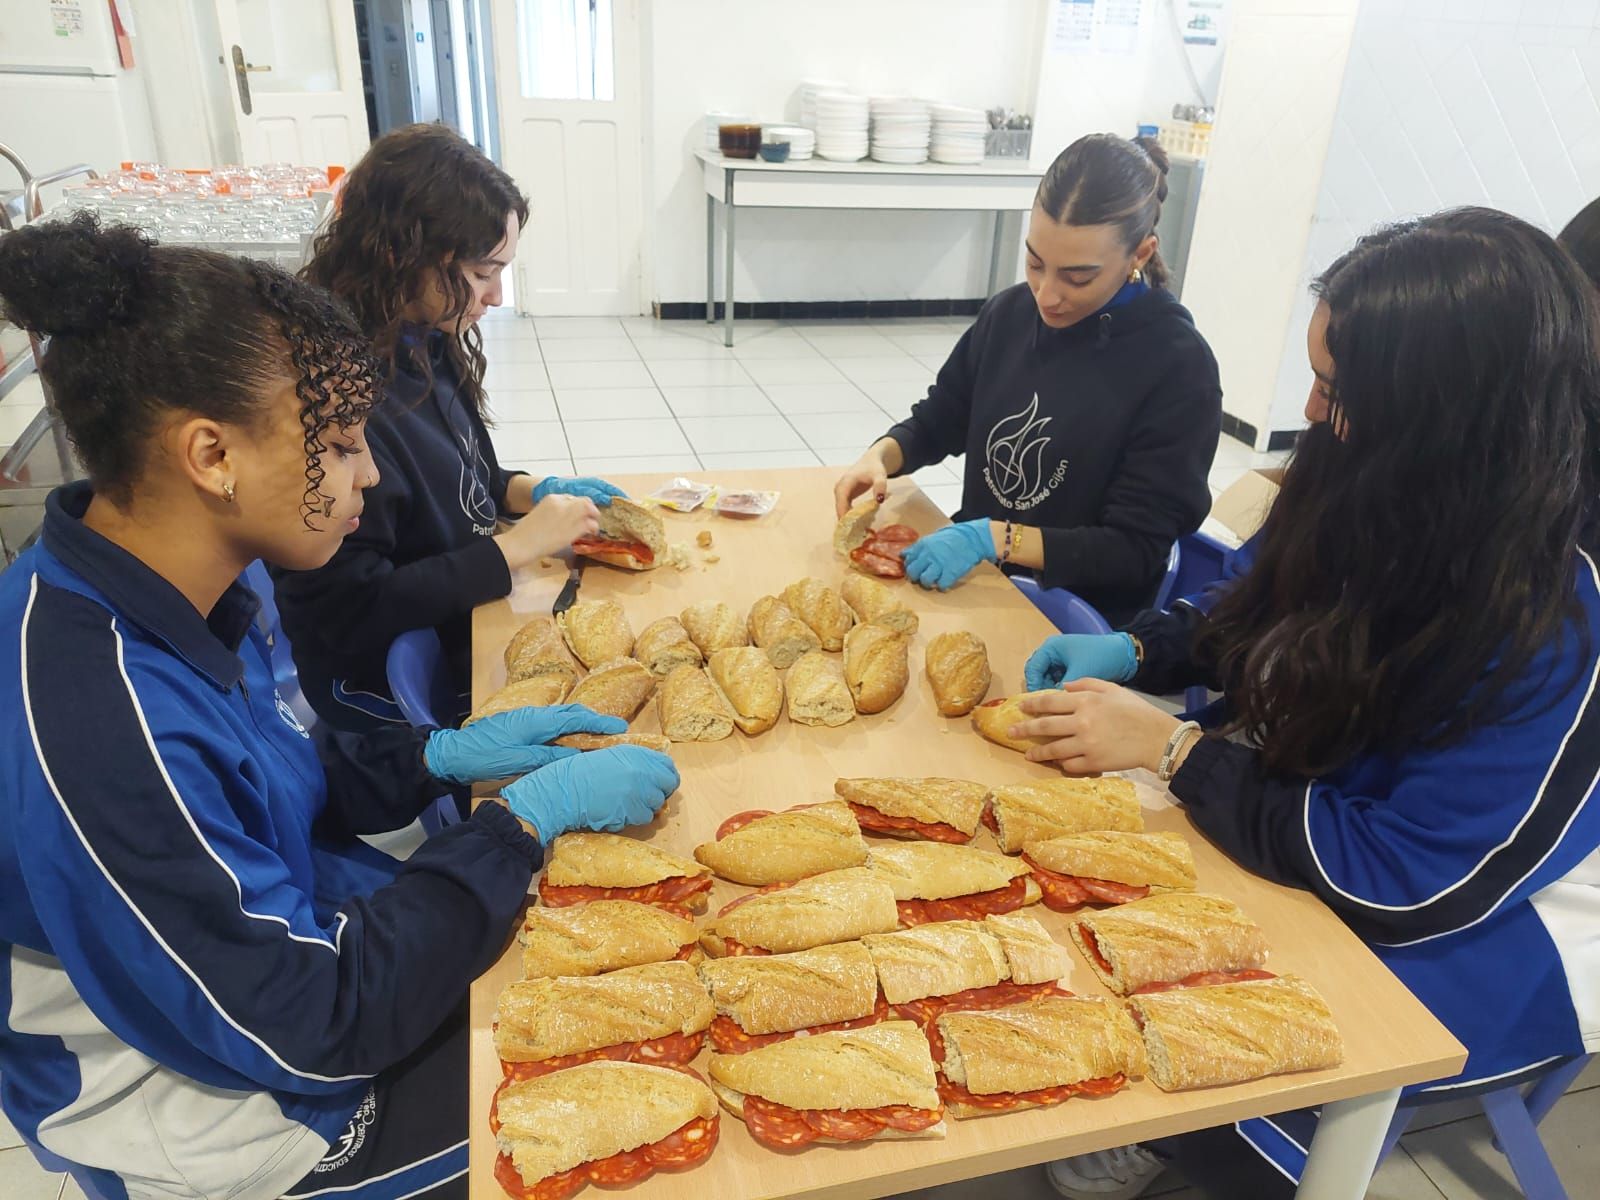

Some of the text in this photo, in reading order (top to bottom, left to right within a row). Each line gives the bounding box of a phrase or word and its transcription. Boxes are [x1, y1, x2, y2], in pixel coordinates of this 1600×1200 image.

[983, 459, 1069, 511] Patronato San José Gijón
